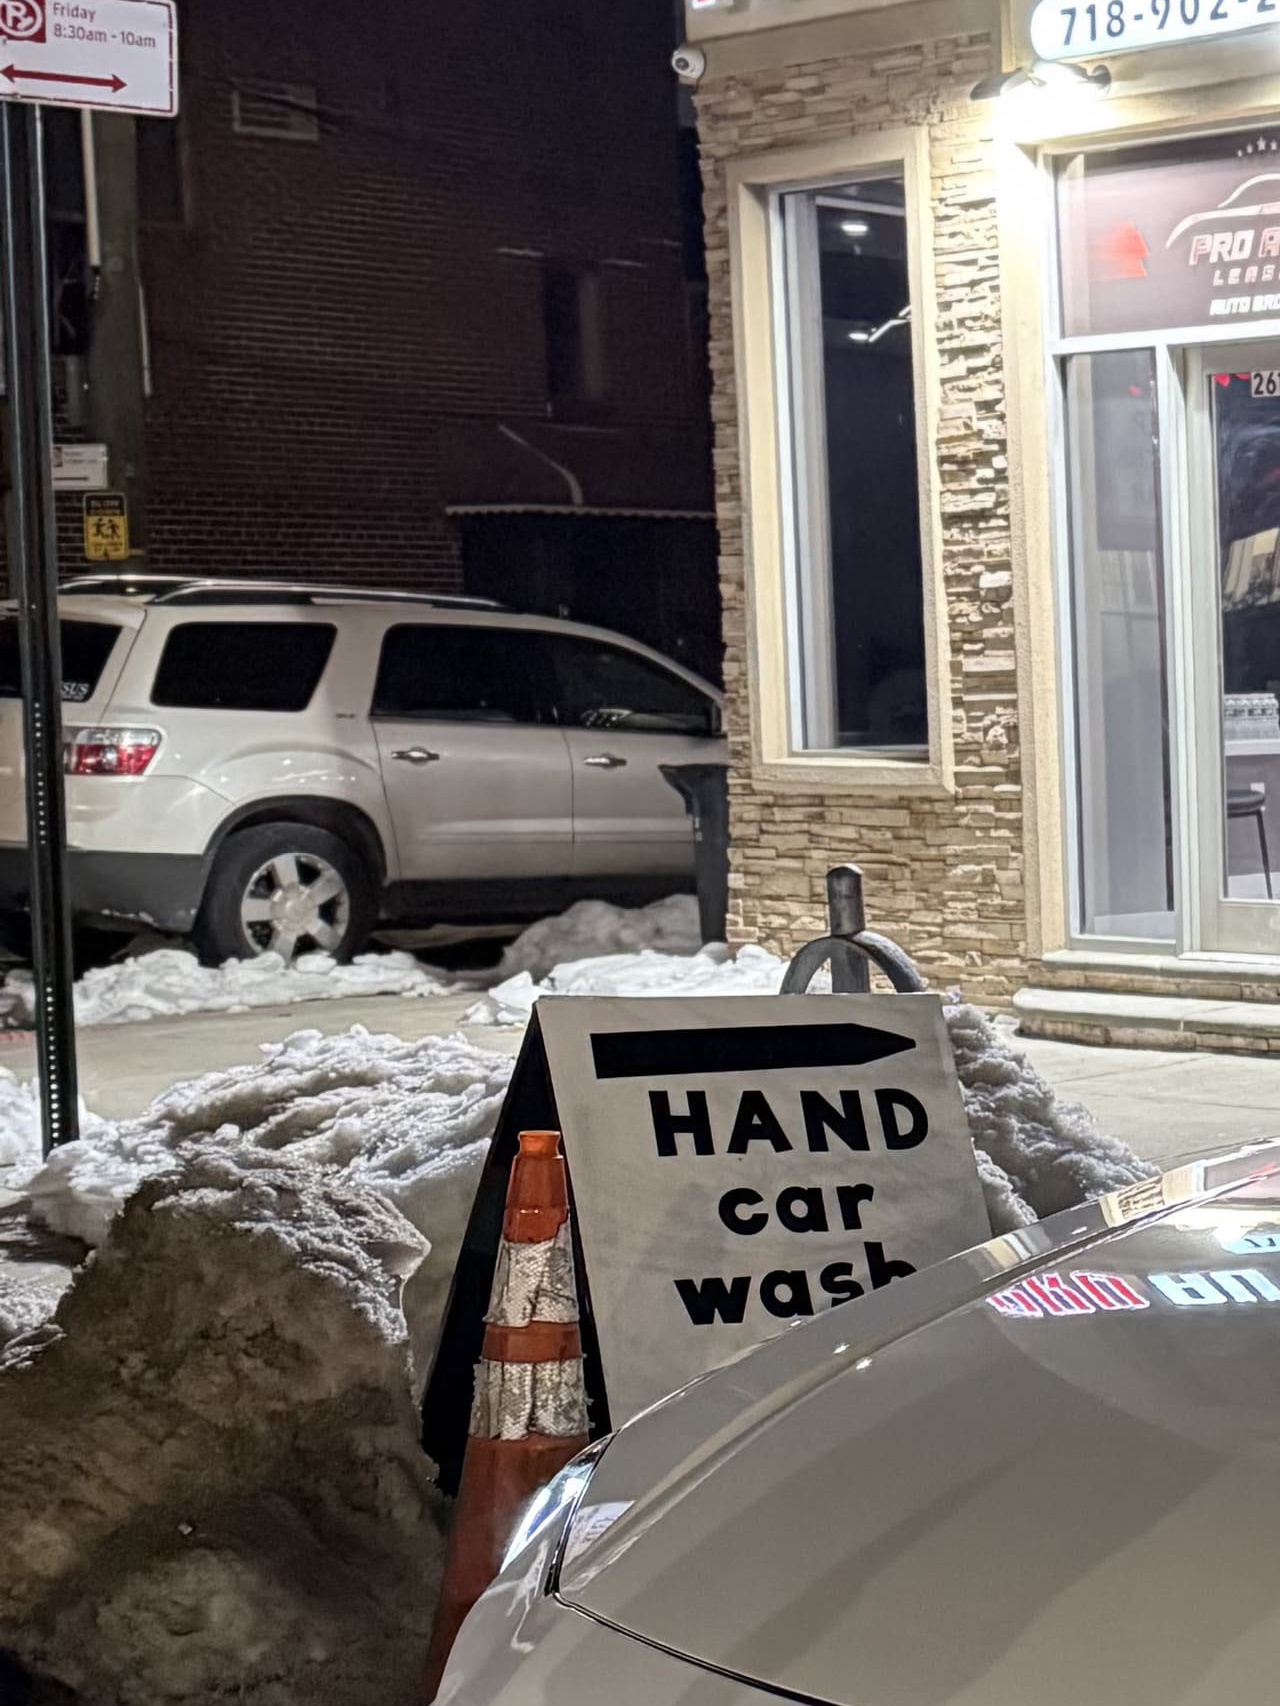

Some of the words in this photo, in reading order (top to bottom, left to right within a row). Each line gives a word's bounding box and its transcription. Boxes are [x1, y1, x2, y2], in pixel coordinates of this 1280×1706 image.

[53, 2, 96, 21] Friday
[53, 23, 108, 43] 8:30am
[121, 30, 157, 48] 10am
[1188, 229, 1255, 266] PRO
[1209, 296, 1251, 316] AUTO
[648, 1088, 929, 1157] HAND
[718, 1182, 875, 1235] car
